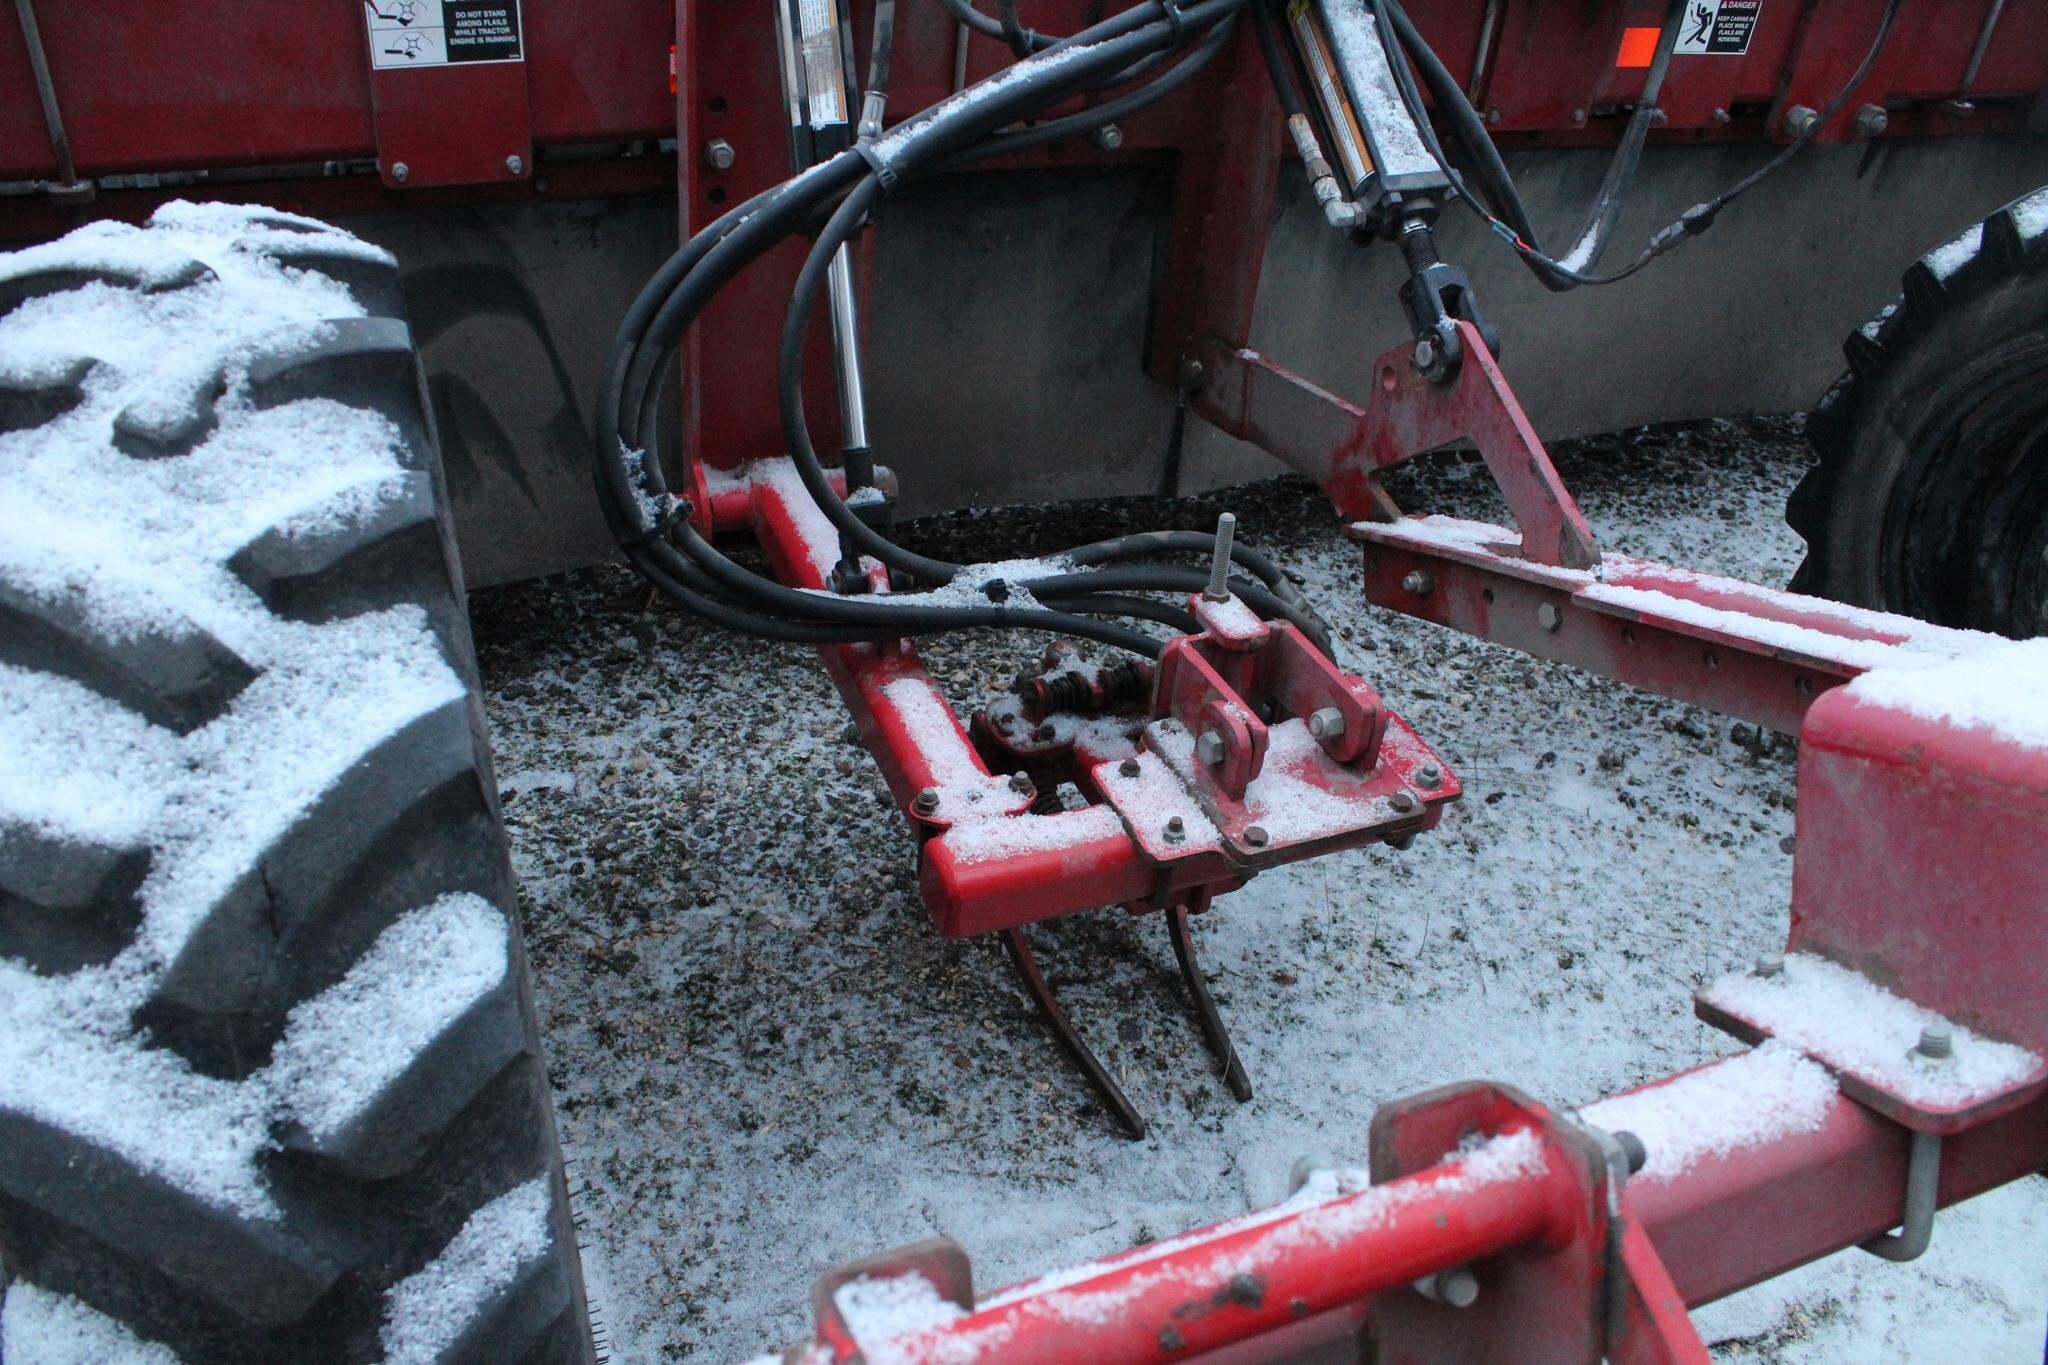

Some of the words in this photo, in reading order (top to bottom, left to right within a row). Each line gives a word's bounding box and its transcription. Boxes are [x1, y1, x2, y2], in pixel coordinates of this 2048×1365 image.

[1728, 1, 1757, 9] DANGER
[455, 11, 466, 19] DO
[467, 10, 482, 18] NOT
[456, 19, 483, 27] AMONG
[483, 18, 507, 26] FLAILS
[454, 28, 477, 36] WHILE
[478, 27, 511, 35] TRACTOR
[450, 37, 476, 45] ENGINE
[477, 36, 484, 44] IS
[485, 35, 517, 43] RUNNING
